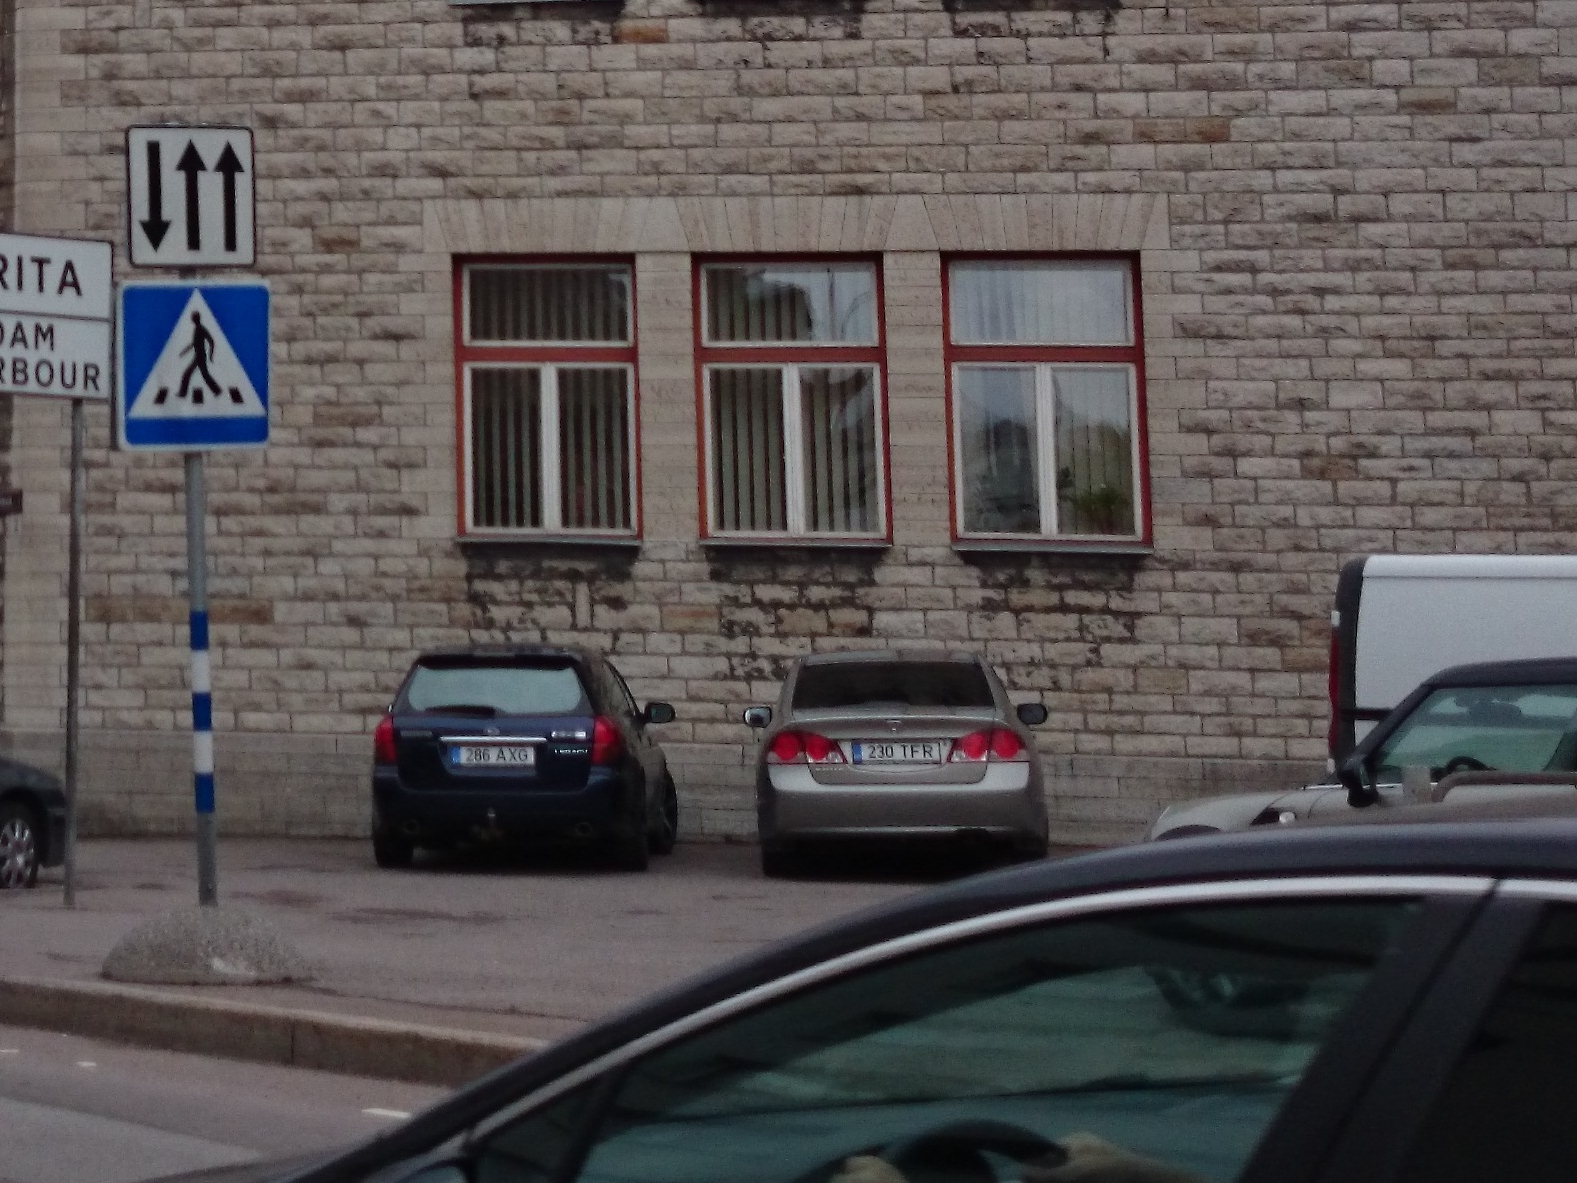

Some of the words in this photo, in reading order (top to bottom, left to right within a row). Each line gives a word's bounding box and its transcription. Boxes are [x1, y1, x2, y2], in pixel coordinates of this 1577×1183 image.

[465, 748, 491, 762] 286
[496, 747, 529, 762] AXG
[868, 744, 894, 759] 230
[902, 744, 934, 759] TFR
